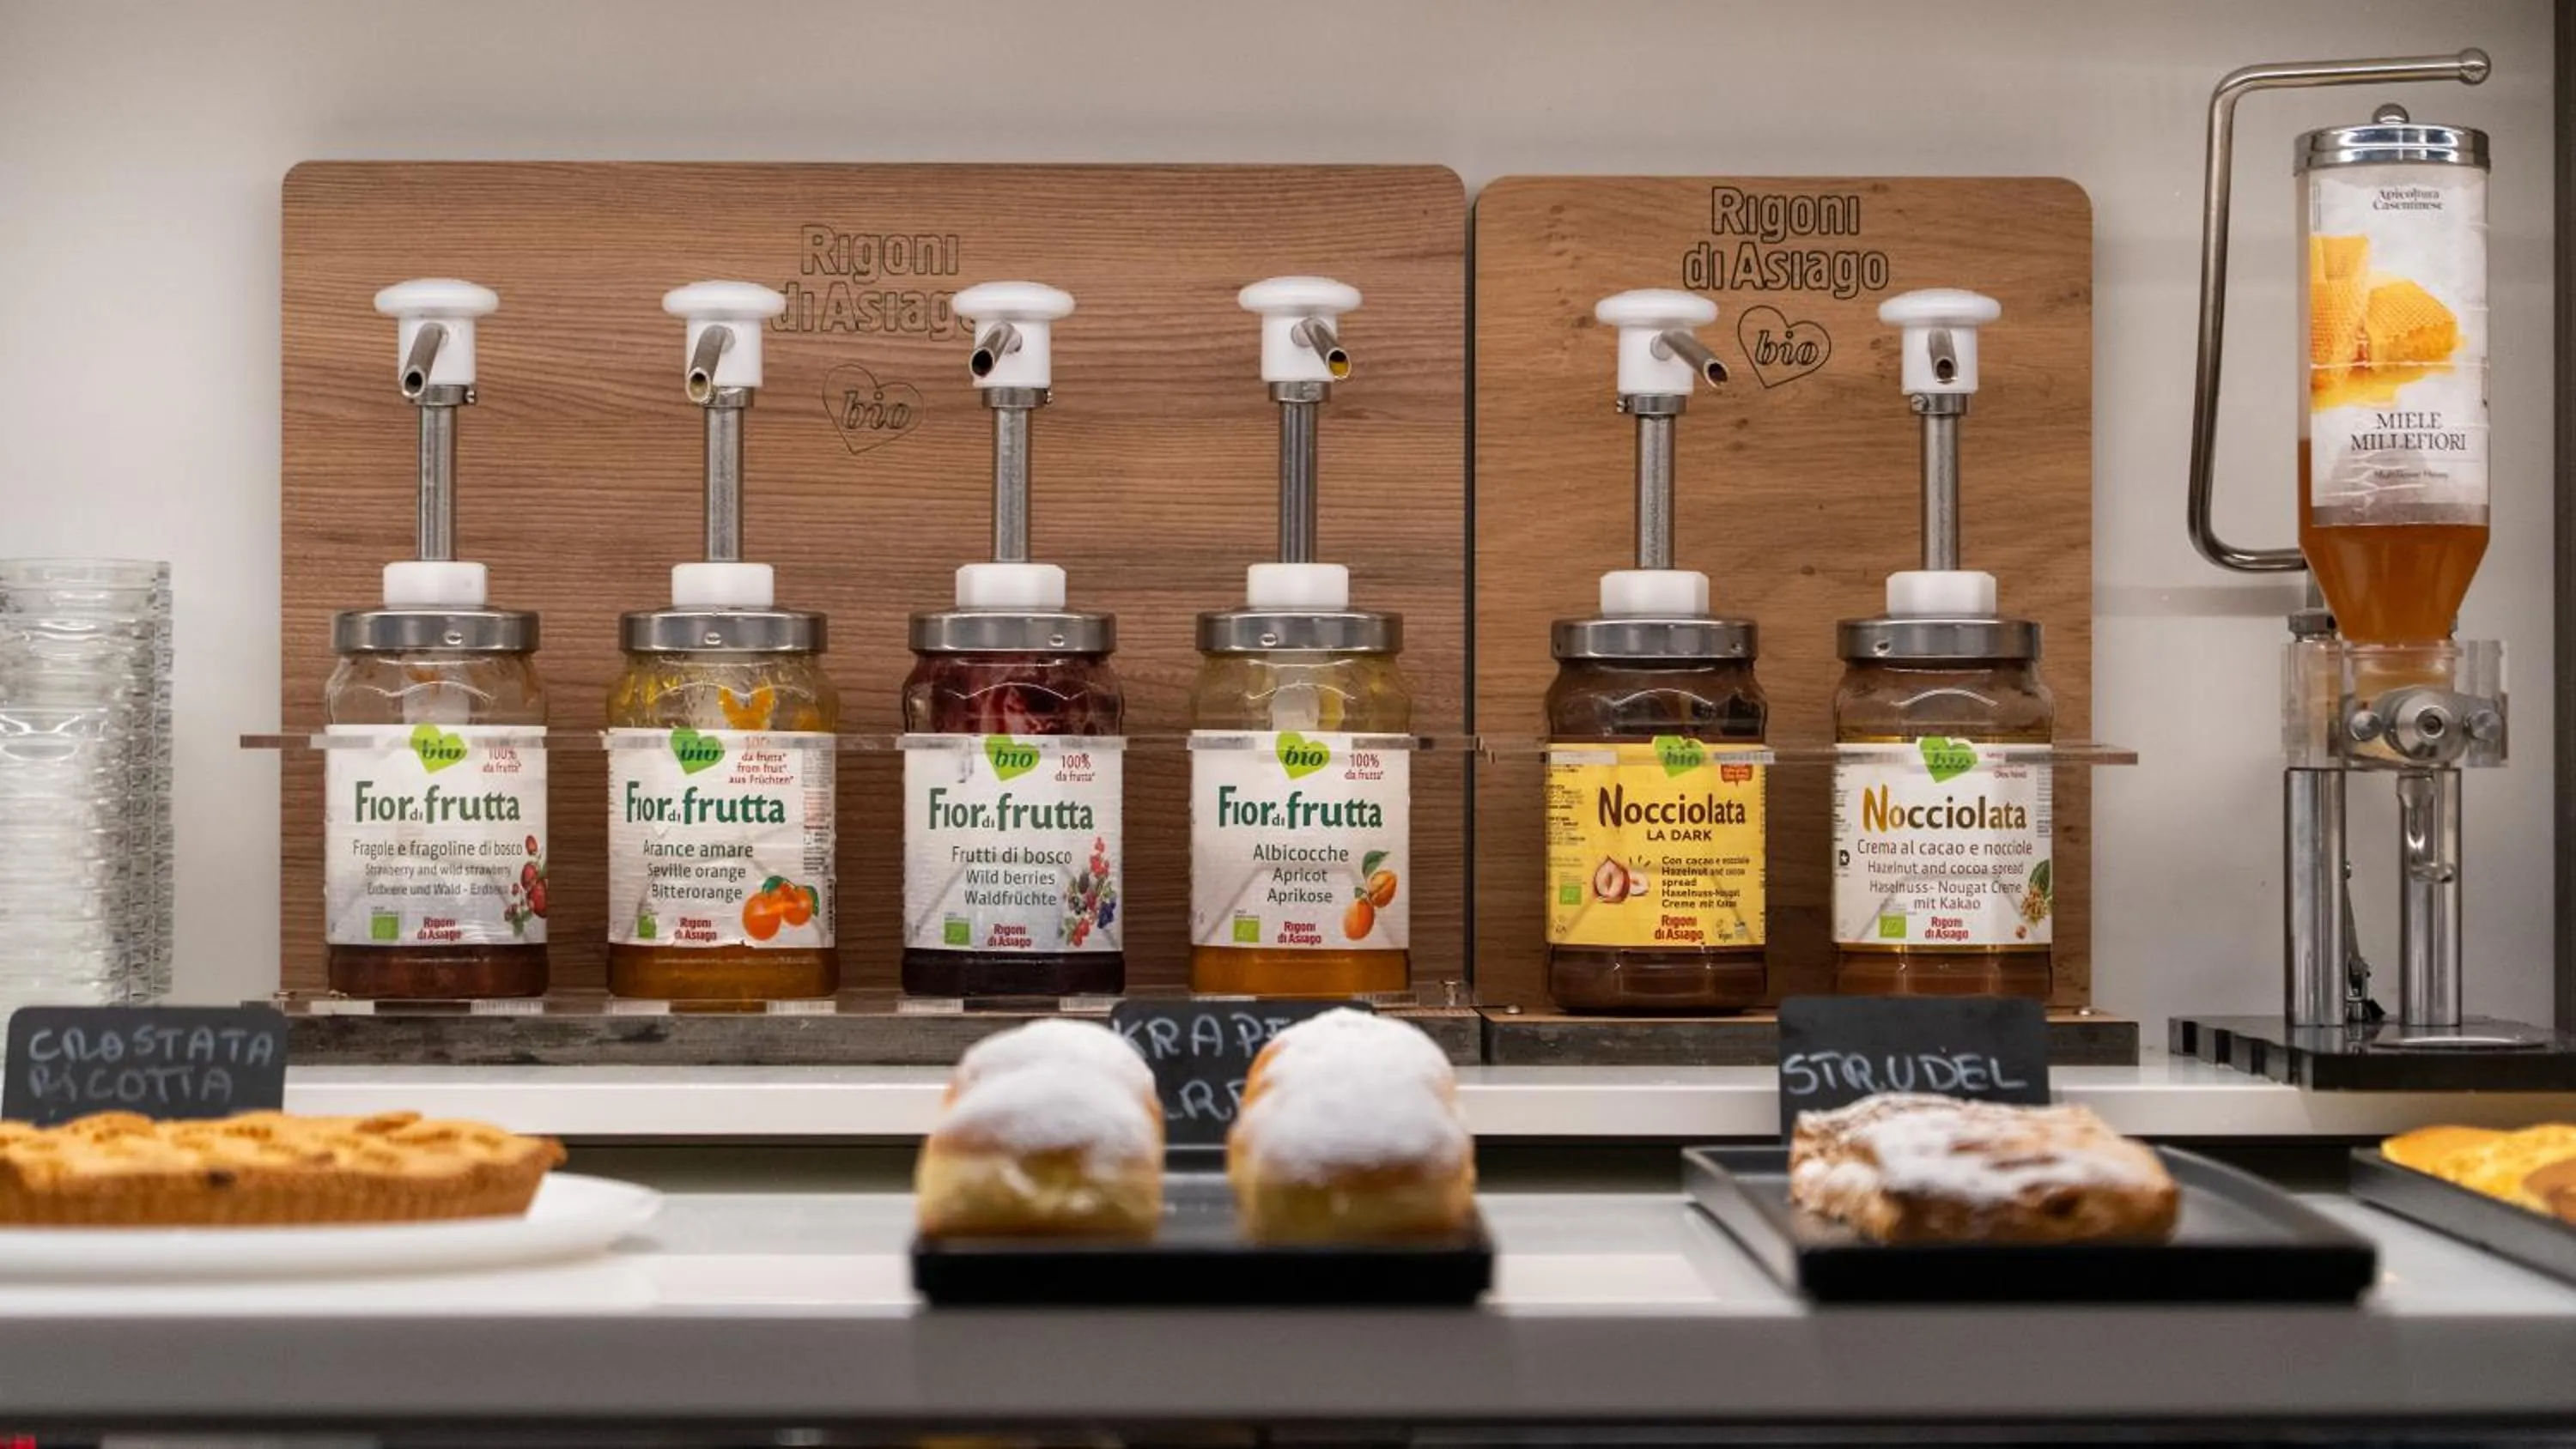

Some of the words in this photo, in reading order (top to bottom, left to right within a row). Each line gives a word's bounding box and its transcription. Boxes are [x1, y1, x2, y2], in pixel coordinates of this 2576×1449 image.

[1711, 185, 1860, 244] Rigoni
[800, 224, 959, 284] Rigoni
[1683, 240, 1724, 290] di
[1730, 241, 1889, 300] Asiago
[771, 281, 815, 332] di
[821, 281, 976, 342] Asiag
[1755, 330, 1819, 365] bio
[841, 390, 911, 429] bio
[2377, 411, 2442, 429] MIELE
[2350, 433, 2467, 451] MILLEFIORI
[995, 748, 1033, 768] bio
[1061, 754, 1091, 769] 100%
[1285, 746, 1323, 767] bio
[1349, 753, 1379, 767] 100%
[1599, 783, 1746, 827] Nocciolata
[1862, 784, 2026, 833] Nocciolata
[1647, 829, 1665, 841] LA
[1671, 829, 1711, 841] DARK
[353, 840, 394, 859] Fragole
[398, 843, 406, 856] e
[410, 840, 475, 859] fragoline
[479, 840, 492, 856] di
[494, 840, 522, 856] bosco
[644, 841, 695, 858] Arance
[700, 844, 753, 858] amare
[1253, 844, 1349, 862] Albicocche
[1857, 839, 1897, 855] Crema
[1900, 840, 1914, 855] al
[1919, 844, 1965, 856] cacao
[1969, 844, 1979, 856] e
[1984, 840, 2032, 855] nocciole
[952, 846, 996, 864] Frutti
[1002, 846, 1018, 864] di
[1024, 847, 1072, 865] bosco
[1662, 856, 1681, 864] Con
[417, 864, 437, 876] and
[440, 864, 461, 876] wild
[647, 864, 691, 877] Seville
[696, 866, 746, 882] orange
[1273, 867, 1327, 884] Apricot
[1662, 866, 1708, 876] Hazelnut
[1868, 861, 1917, 875] Hazelnut
[1921, 861, 1946, 875] and
[1950, 864, 1988, 876] cocoa
[1991, 862, 2024, 876] spread
[966, 870, 999, 885] Wild
[1004, 870, 1055, 885] berries
[1662, 878, 1698, 888] spread
[410, 883, 430, 896] und
[434, 882, 461, 896] Wald
[652, 883, 742, 903] Bitterorange
[1938, 881, 1987, 896] Nougat
[1991, 880, 2021, 894] Creme
[964, 891, 1057, 906] Waldfrüchte
[1267, 888, 1333, 905] Aprikose
[1662, 899, 1695, 908] Creme
[1914, 897, 1935, 910] mit
[1940, 897, 1981, 910] Kakao
[423, 917, 455, 929] Rigoni
[679, 917, 711, 930] Rigoni
[1284, 922, 1315, 934] Rigoni
[1662, 915, 1698, 930] Rigoni
[1931, 916, 1963, 930] Rigoni
[417, 928, 426, 940] di
[427, 928, 462, 941] Asiago
[684, 930, 717, 942] Asiago
[993, 924, 1026, 937] Rigoni
[1655, 928, 1665, 941] di
[1666, 928, 1704, 942] Asiago
[1924, 928, 1935, 940] di
[1935, 928, 1969, 941] Asiago
[998, 936, 1032, 948] Asiago
[1278, 933, 1286, 944] di
[1288, 933, 1321, 945] Asiago
[1782, 1050, 2028, 1095] STRUDEL
